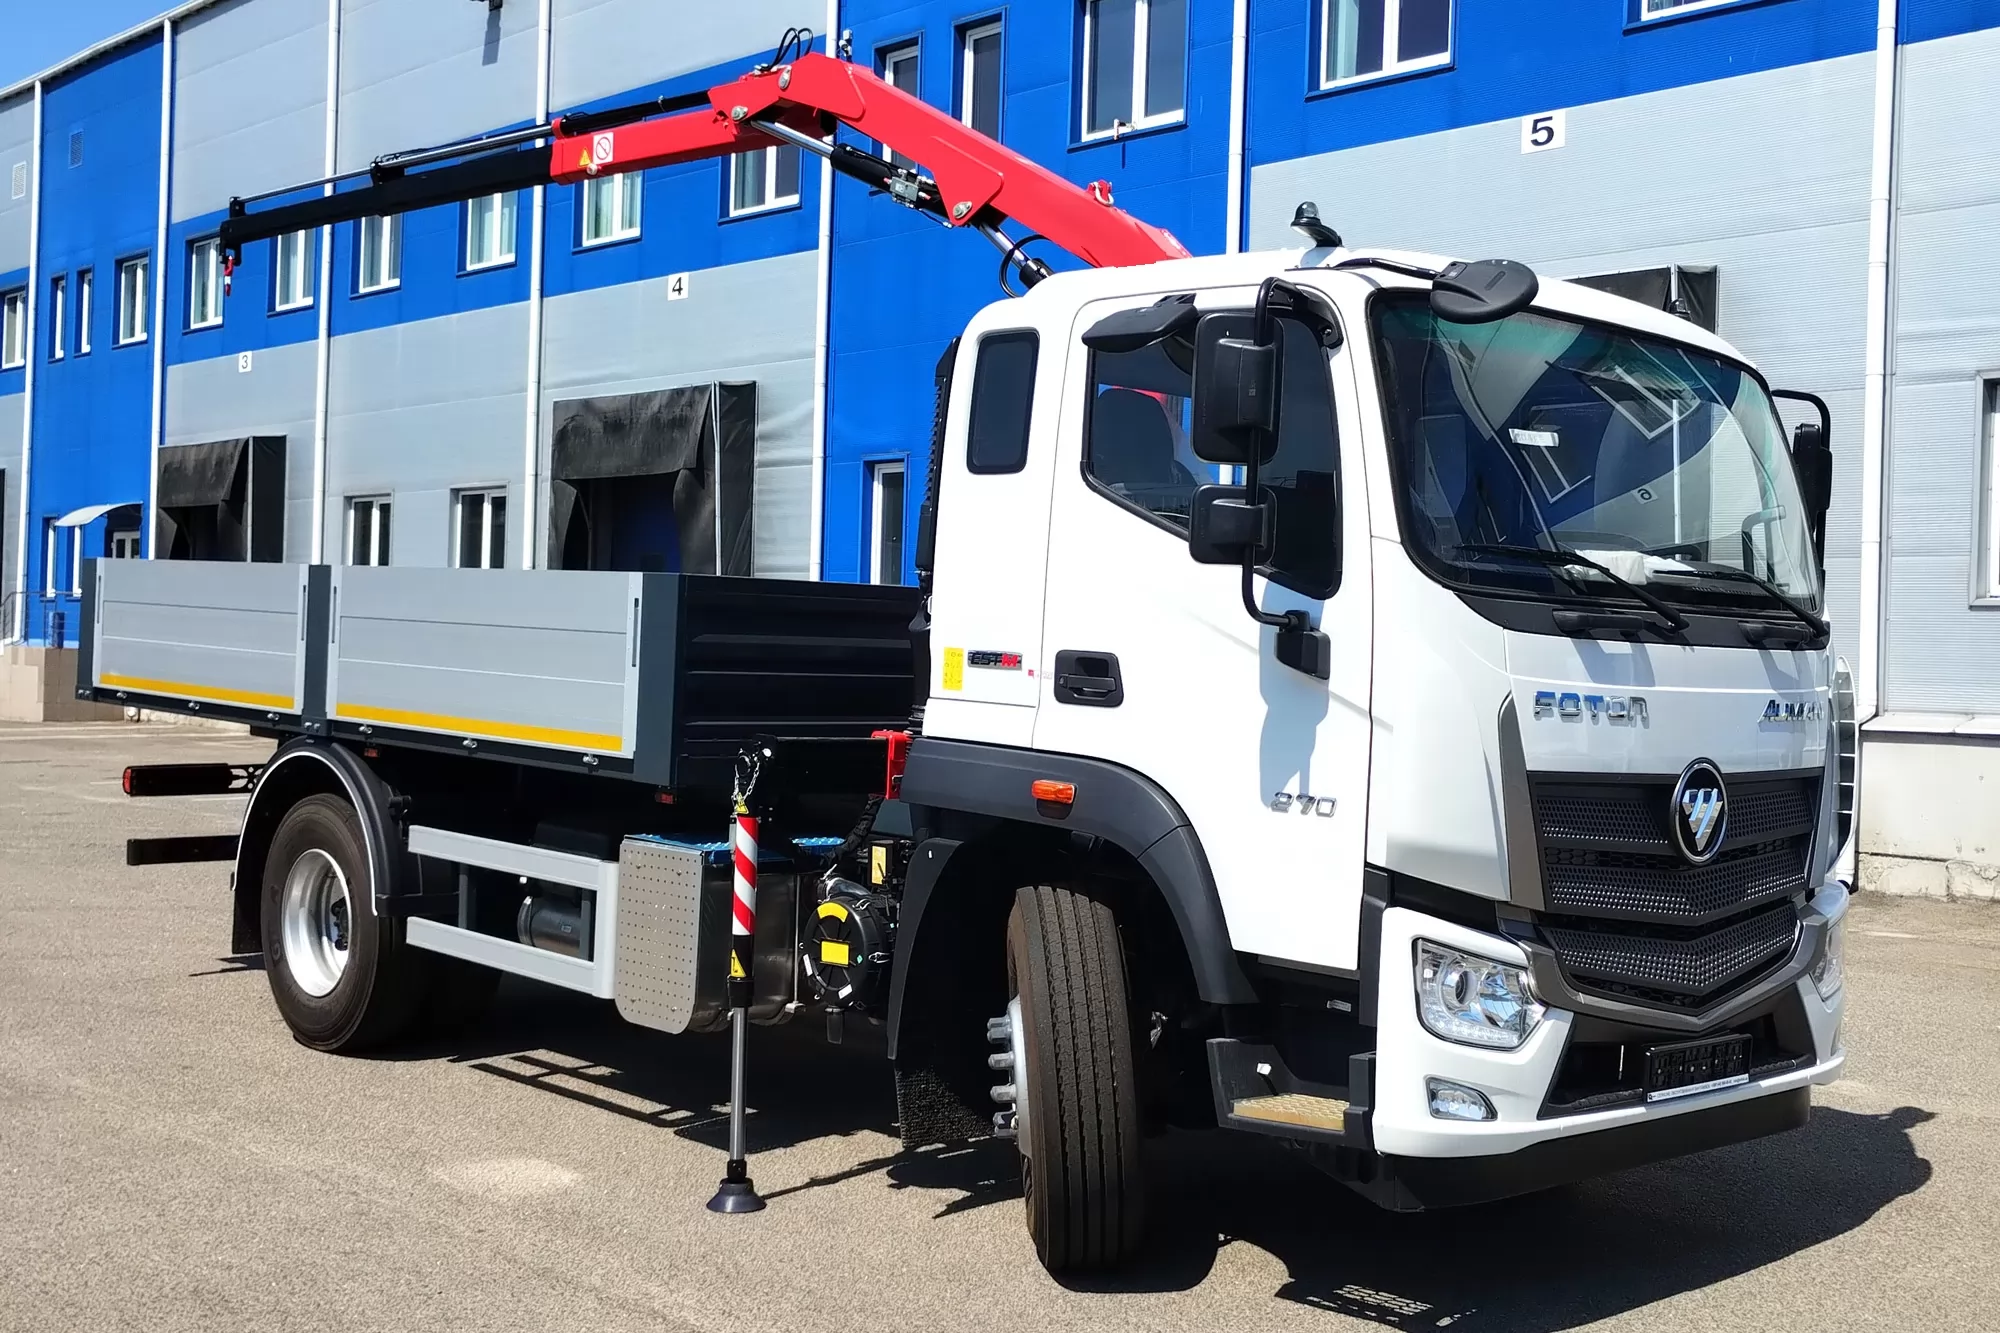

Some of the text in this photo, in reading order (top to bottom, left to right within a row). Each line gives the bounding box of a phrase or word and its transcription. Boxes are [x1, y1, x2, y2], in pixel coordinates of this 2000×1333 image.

[1530, 115, 1555, 147] 5
[671, 276, 684, 297] 4
[241, 354, 249, 370] 3
[1533, 690, 1649, 721] FOTON
[1270, 791, 1338, 818] 270
